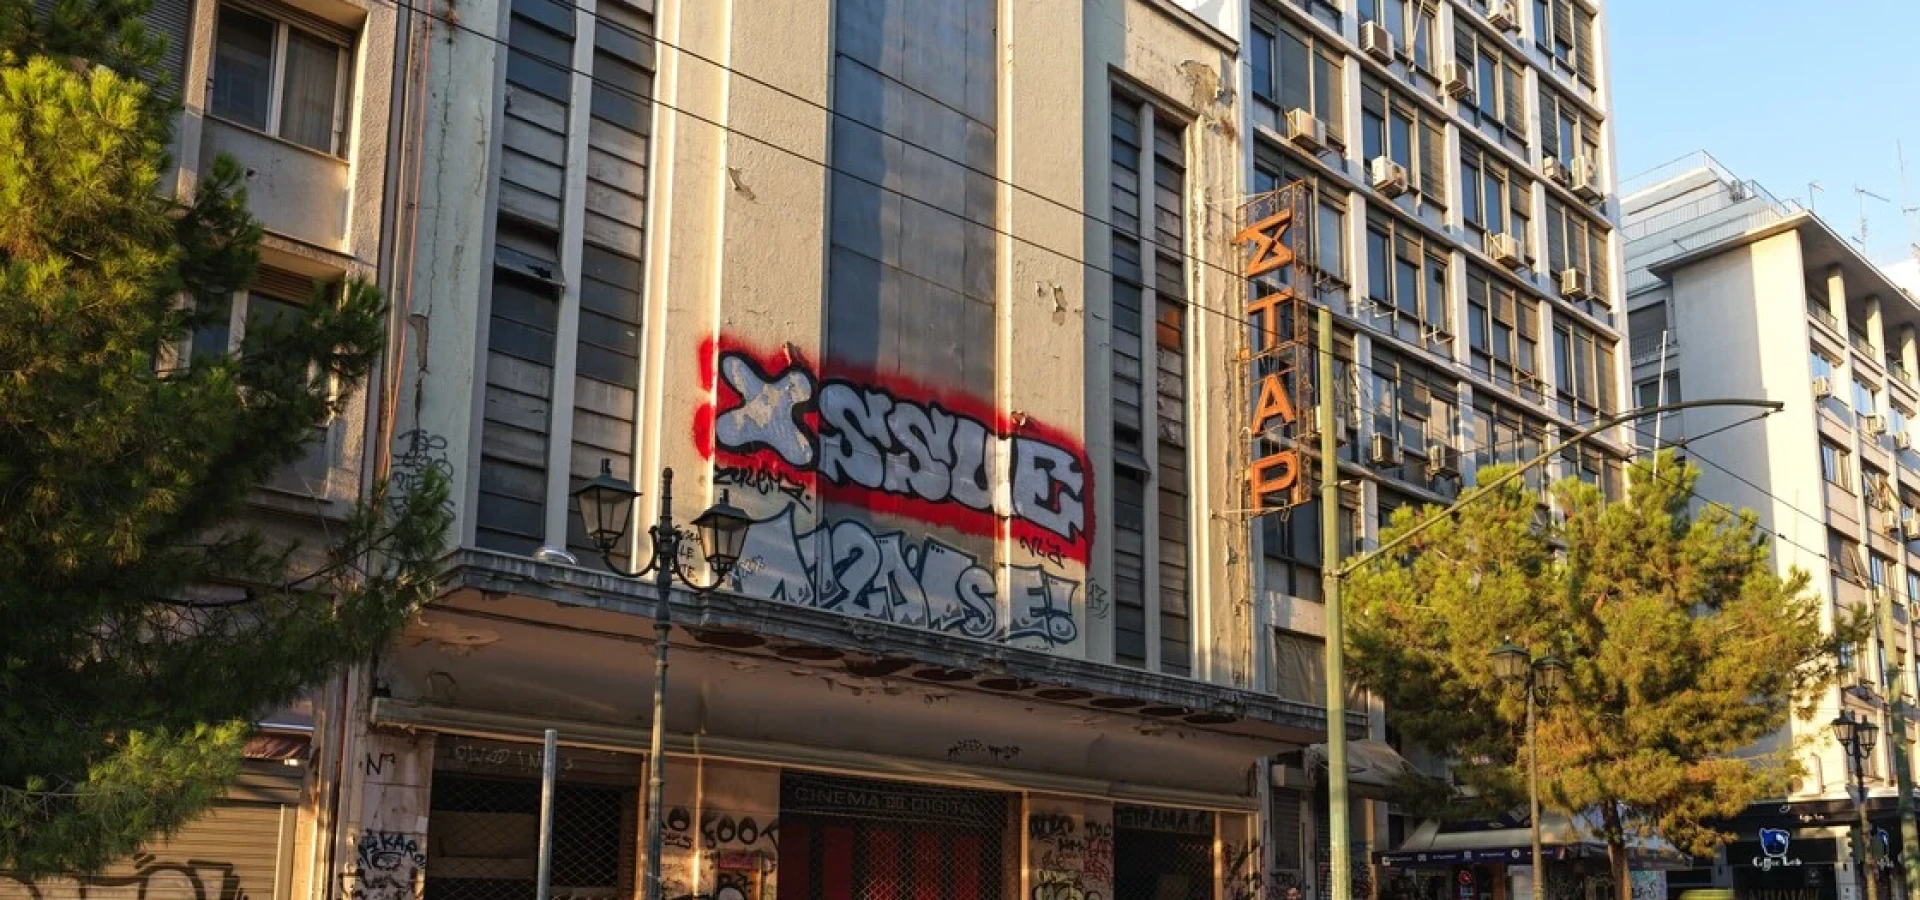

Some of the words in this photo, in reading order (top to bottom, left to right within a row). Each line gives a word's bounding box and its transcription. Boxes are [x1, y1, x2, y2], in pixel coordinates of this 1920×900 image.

[1233, 208, 1298, 516] ΣΤΑΡ
[794, 787, 879, 809] CINEMA
[910, 798, 981, 819] DIGITAL
